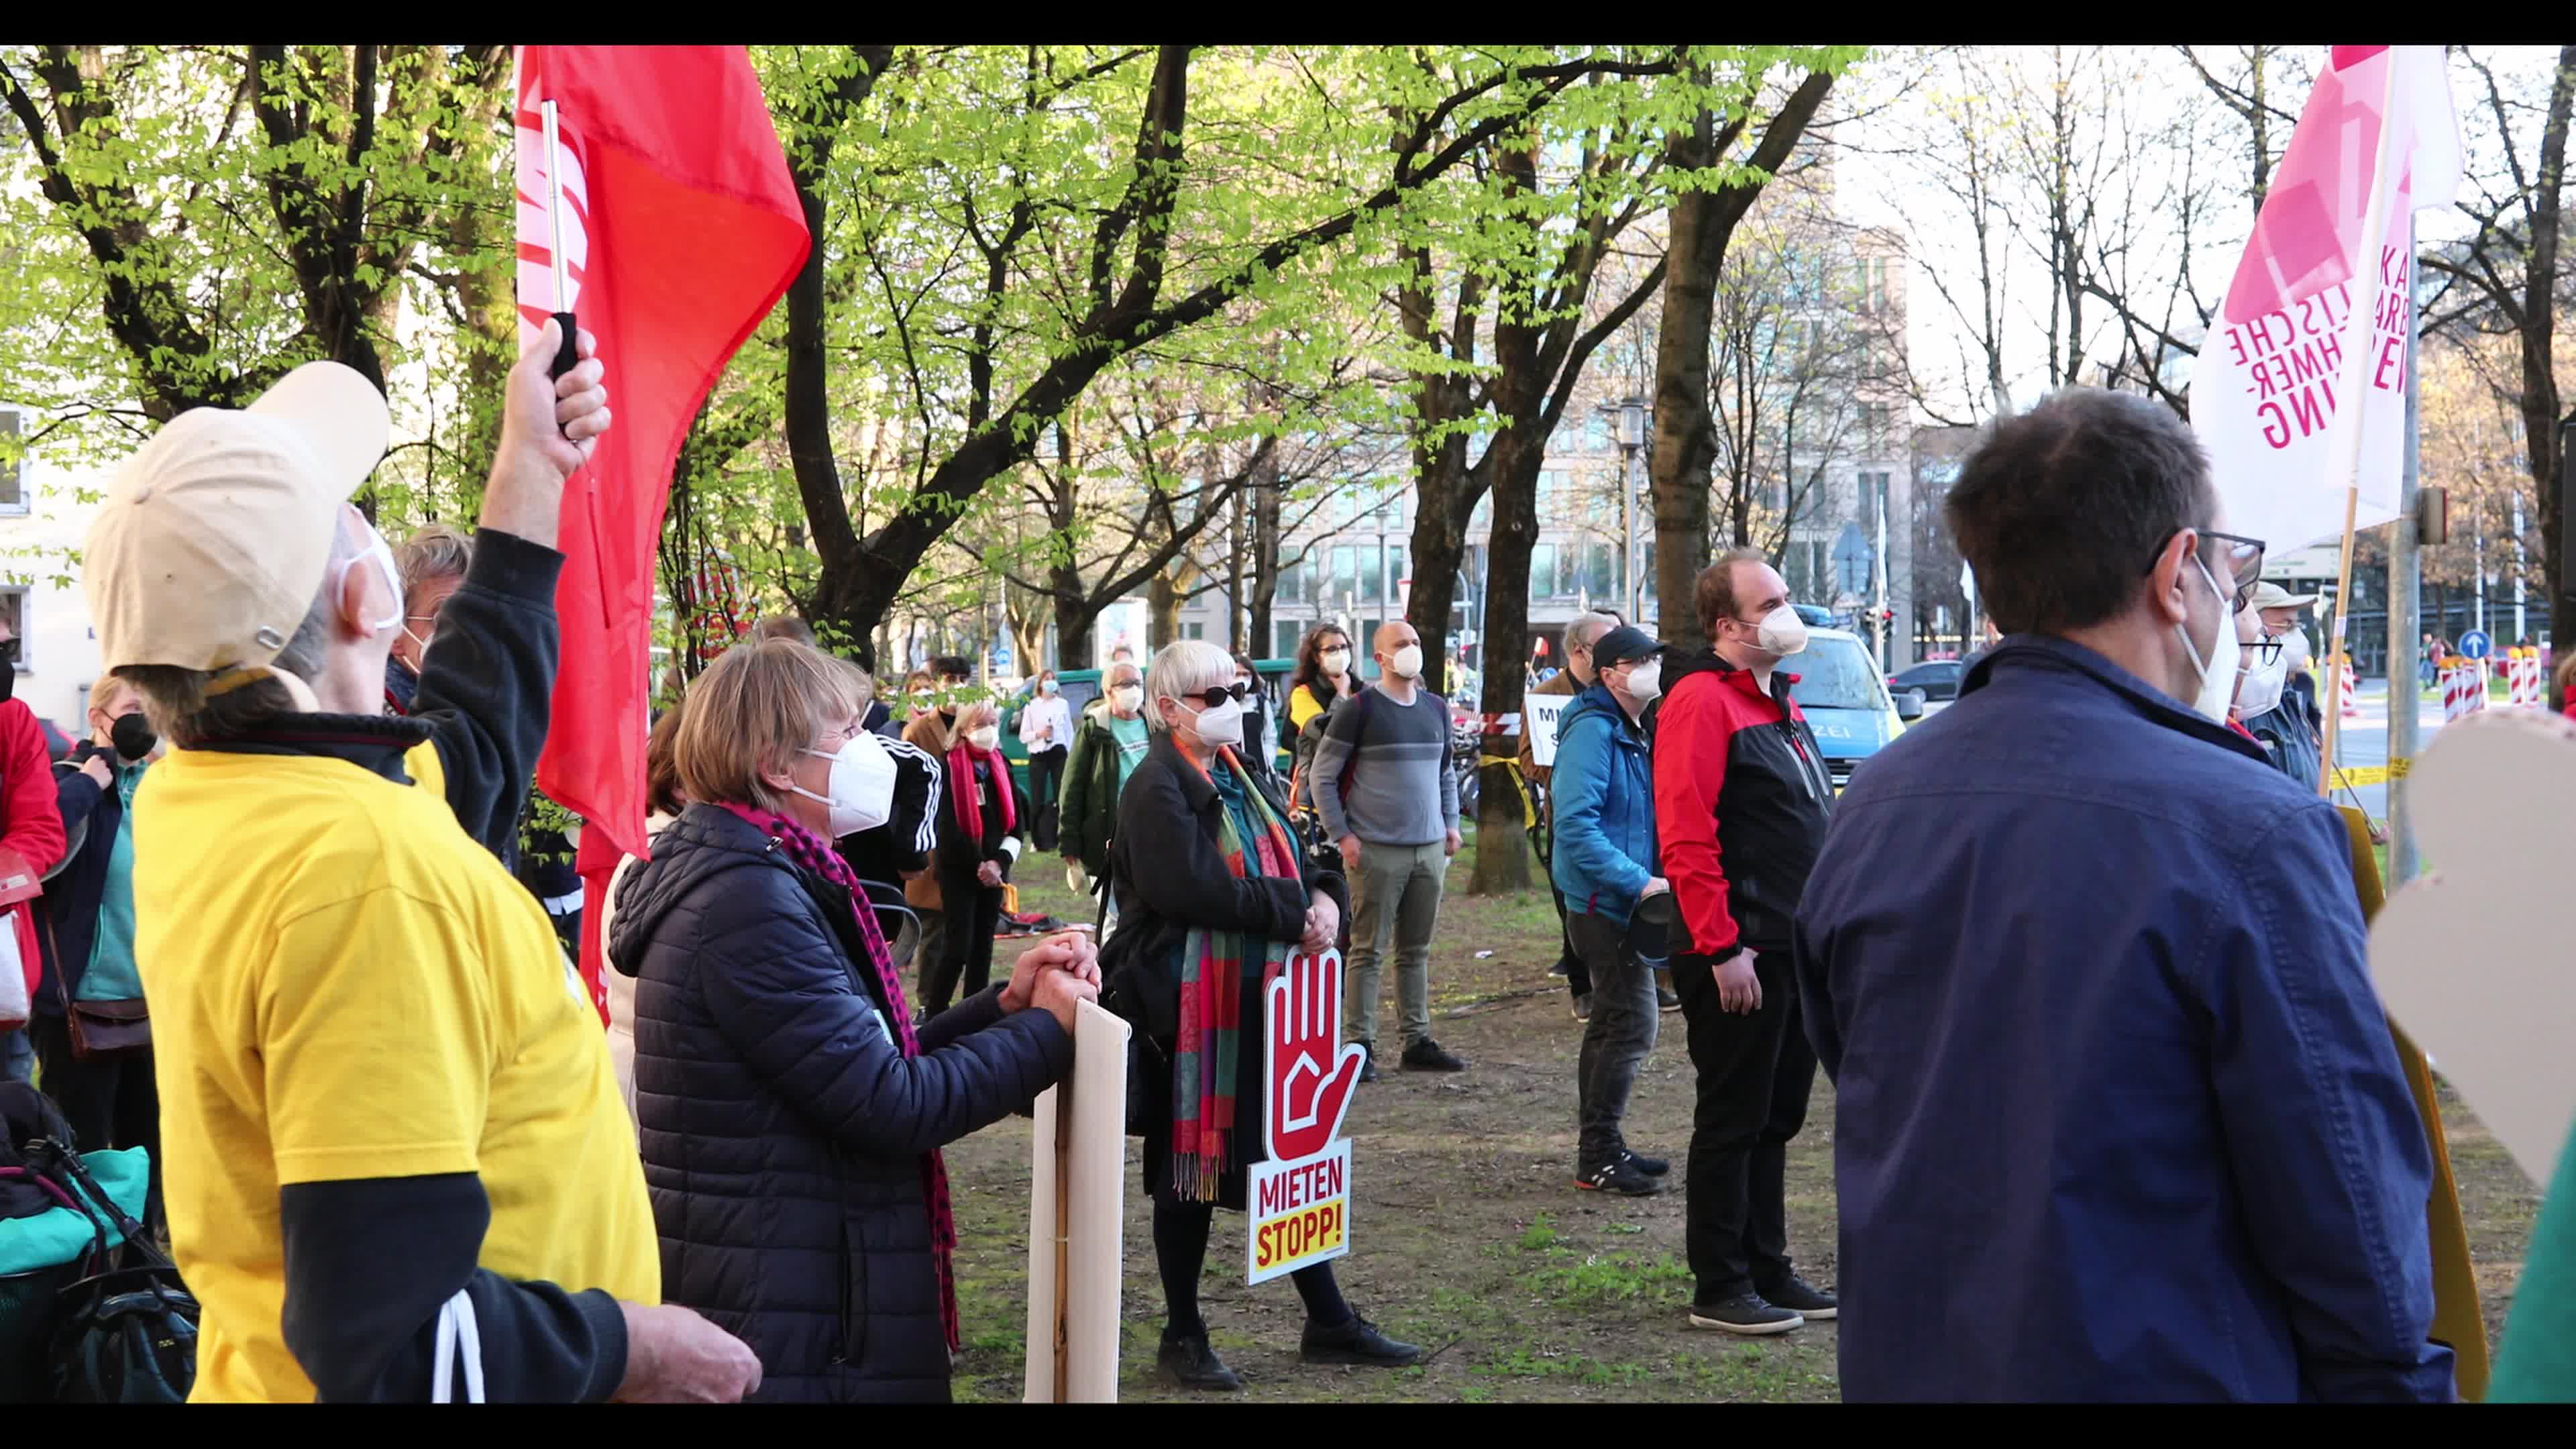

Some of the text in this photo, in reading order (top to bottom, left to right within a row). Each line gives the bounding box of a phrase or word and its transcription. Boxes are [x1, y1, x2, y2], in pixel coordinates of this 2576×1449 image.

[2379, 244, 2408, 292] KA
[1258, 1155, 1342, 1218] MIETEN
[1257, 1203, 1342, 1267] STOPP!
